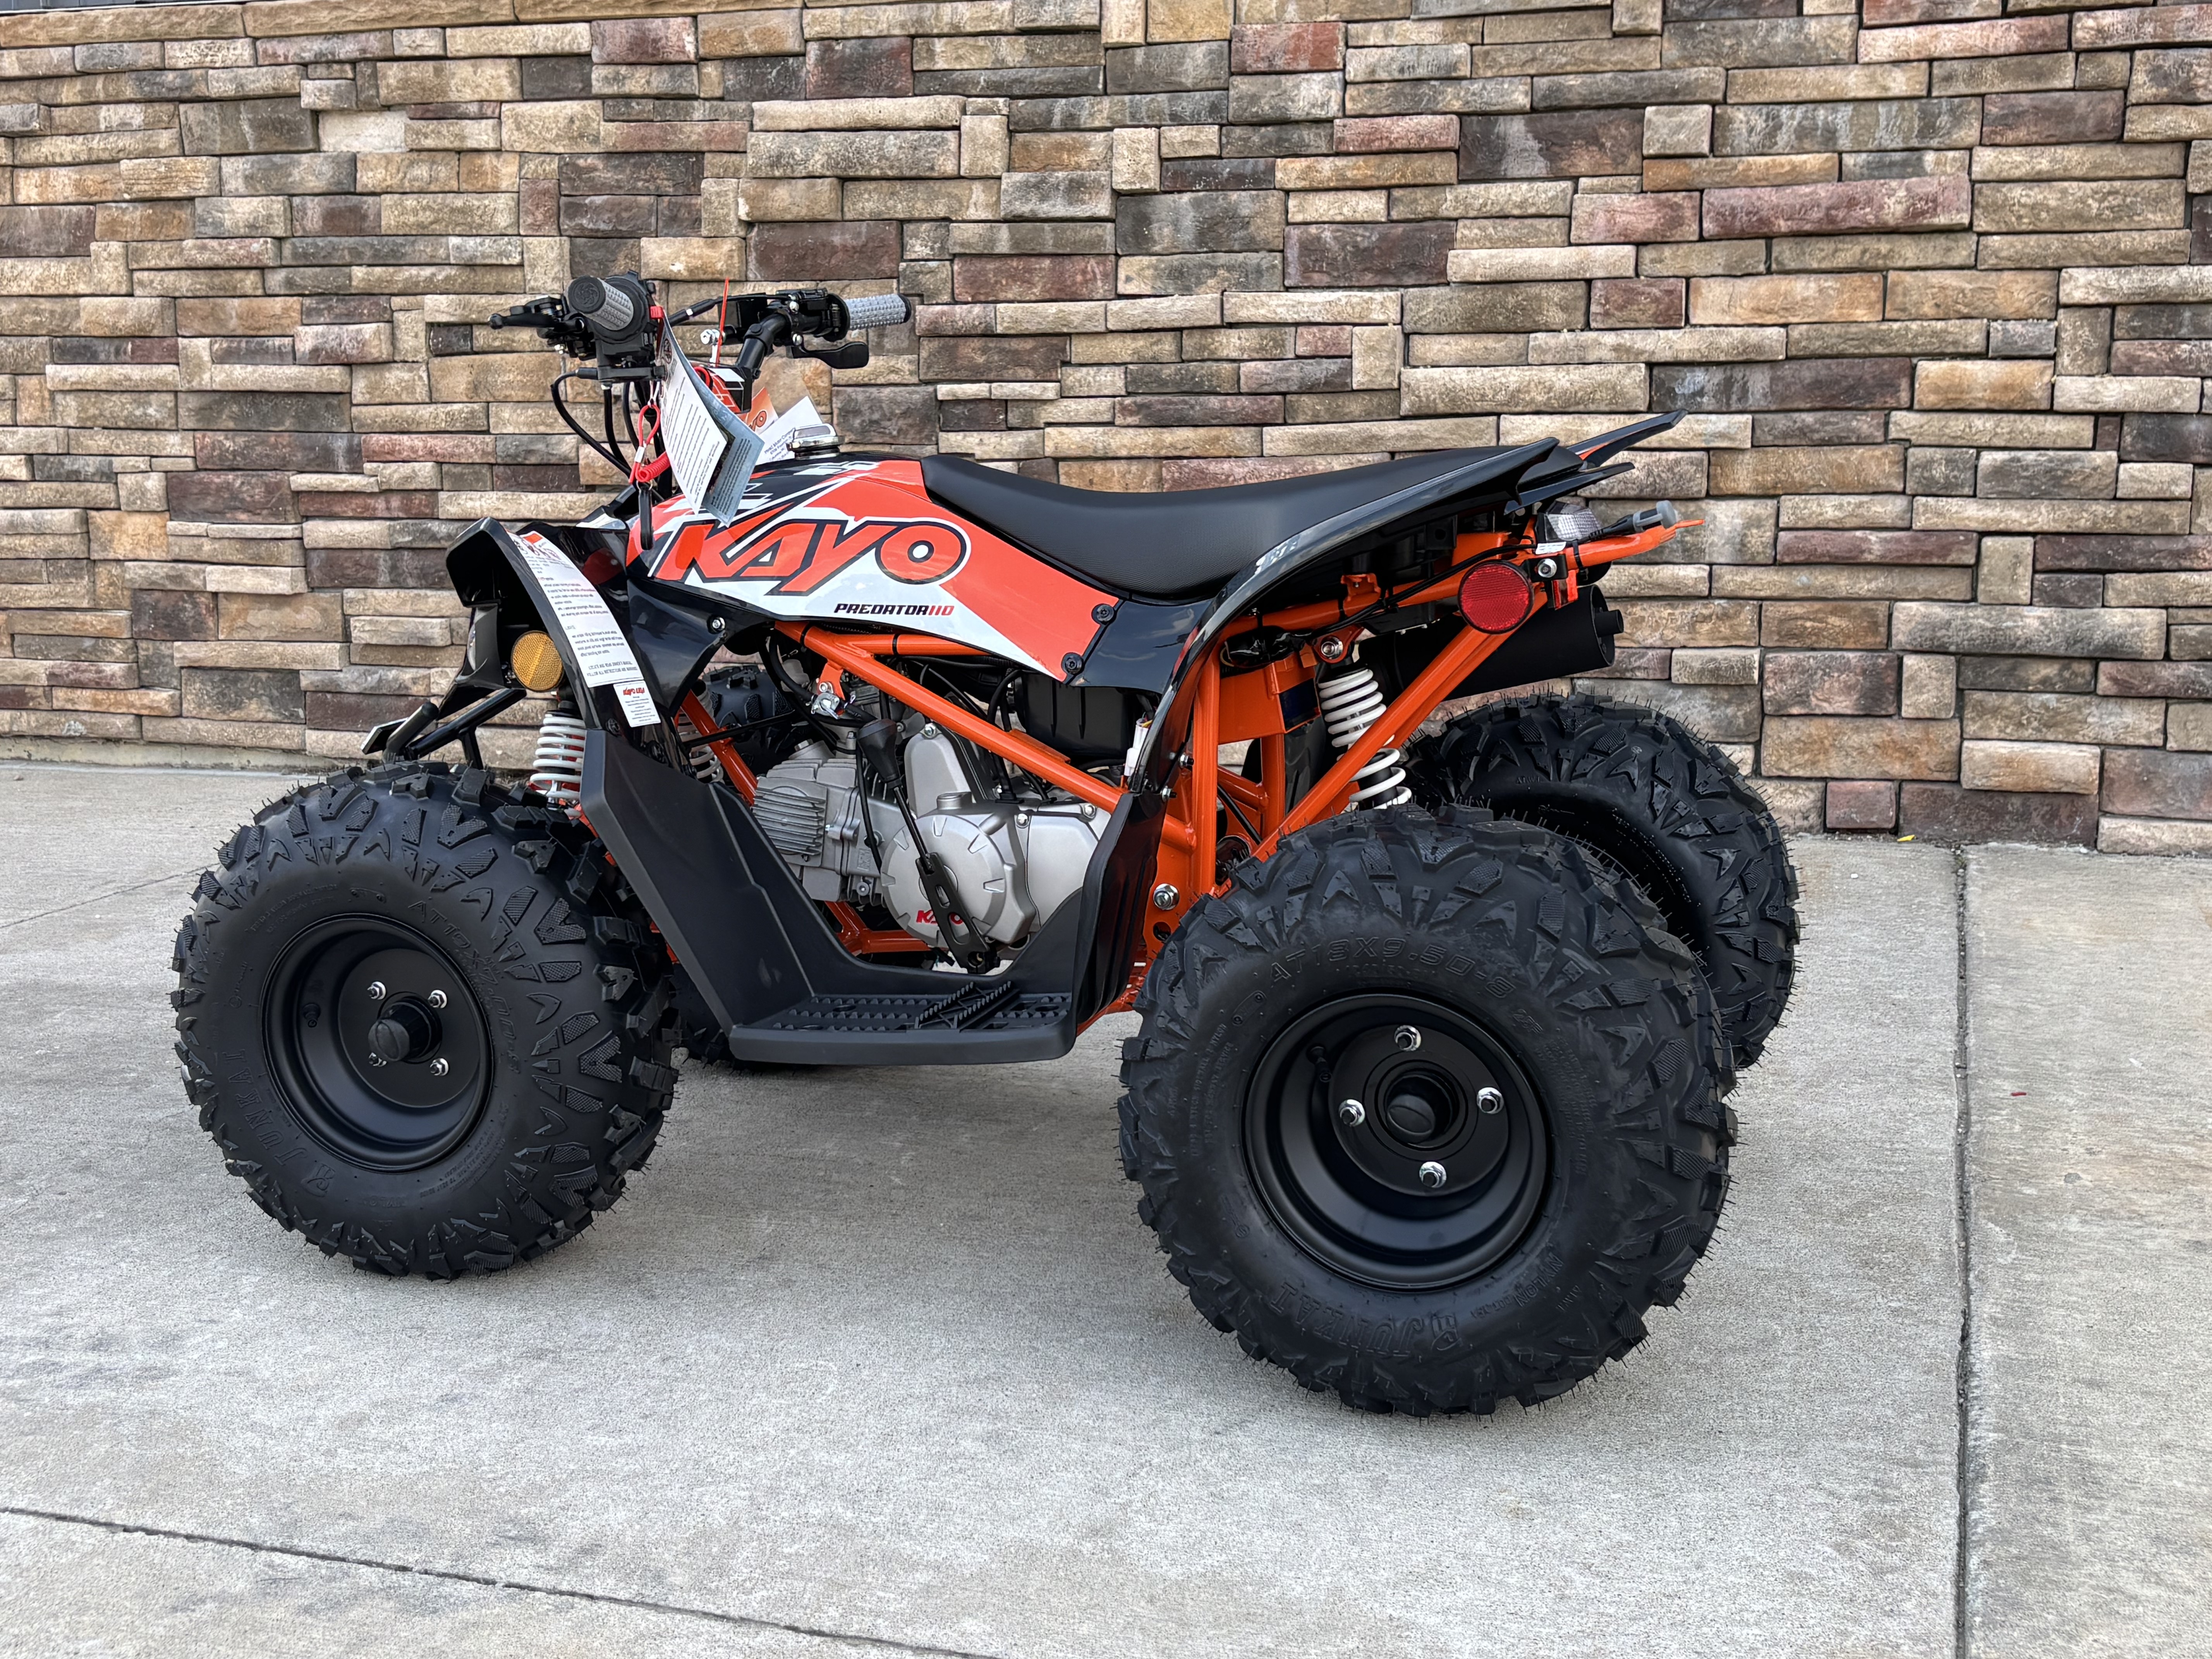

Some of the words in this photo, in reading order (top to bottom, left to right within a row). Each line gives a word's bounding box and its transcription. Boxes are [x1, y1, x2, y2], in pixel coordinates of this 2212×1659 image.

[654, 519, 966, 596] KAYO
[916, 910, 963, 925] KO
[222, 1049, 308, 1166] JUNKAI
[1513, 1252, 1564, 1307] NYLON
[1269, 1281, 1425, 1357] JUNKAI
